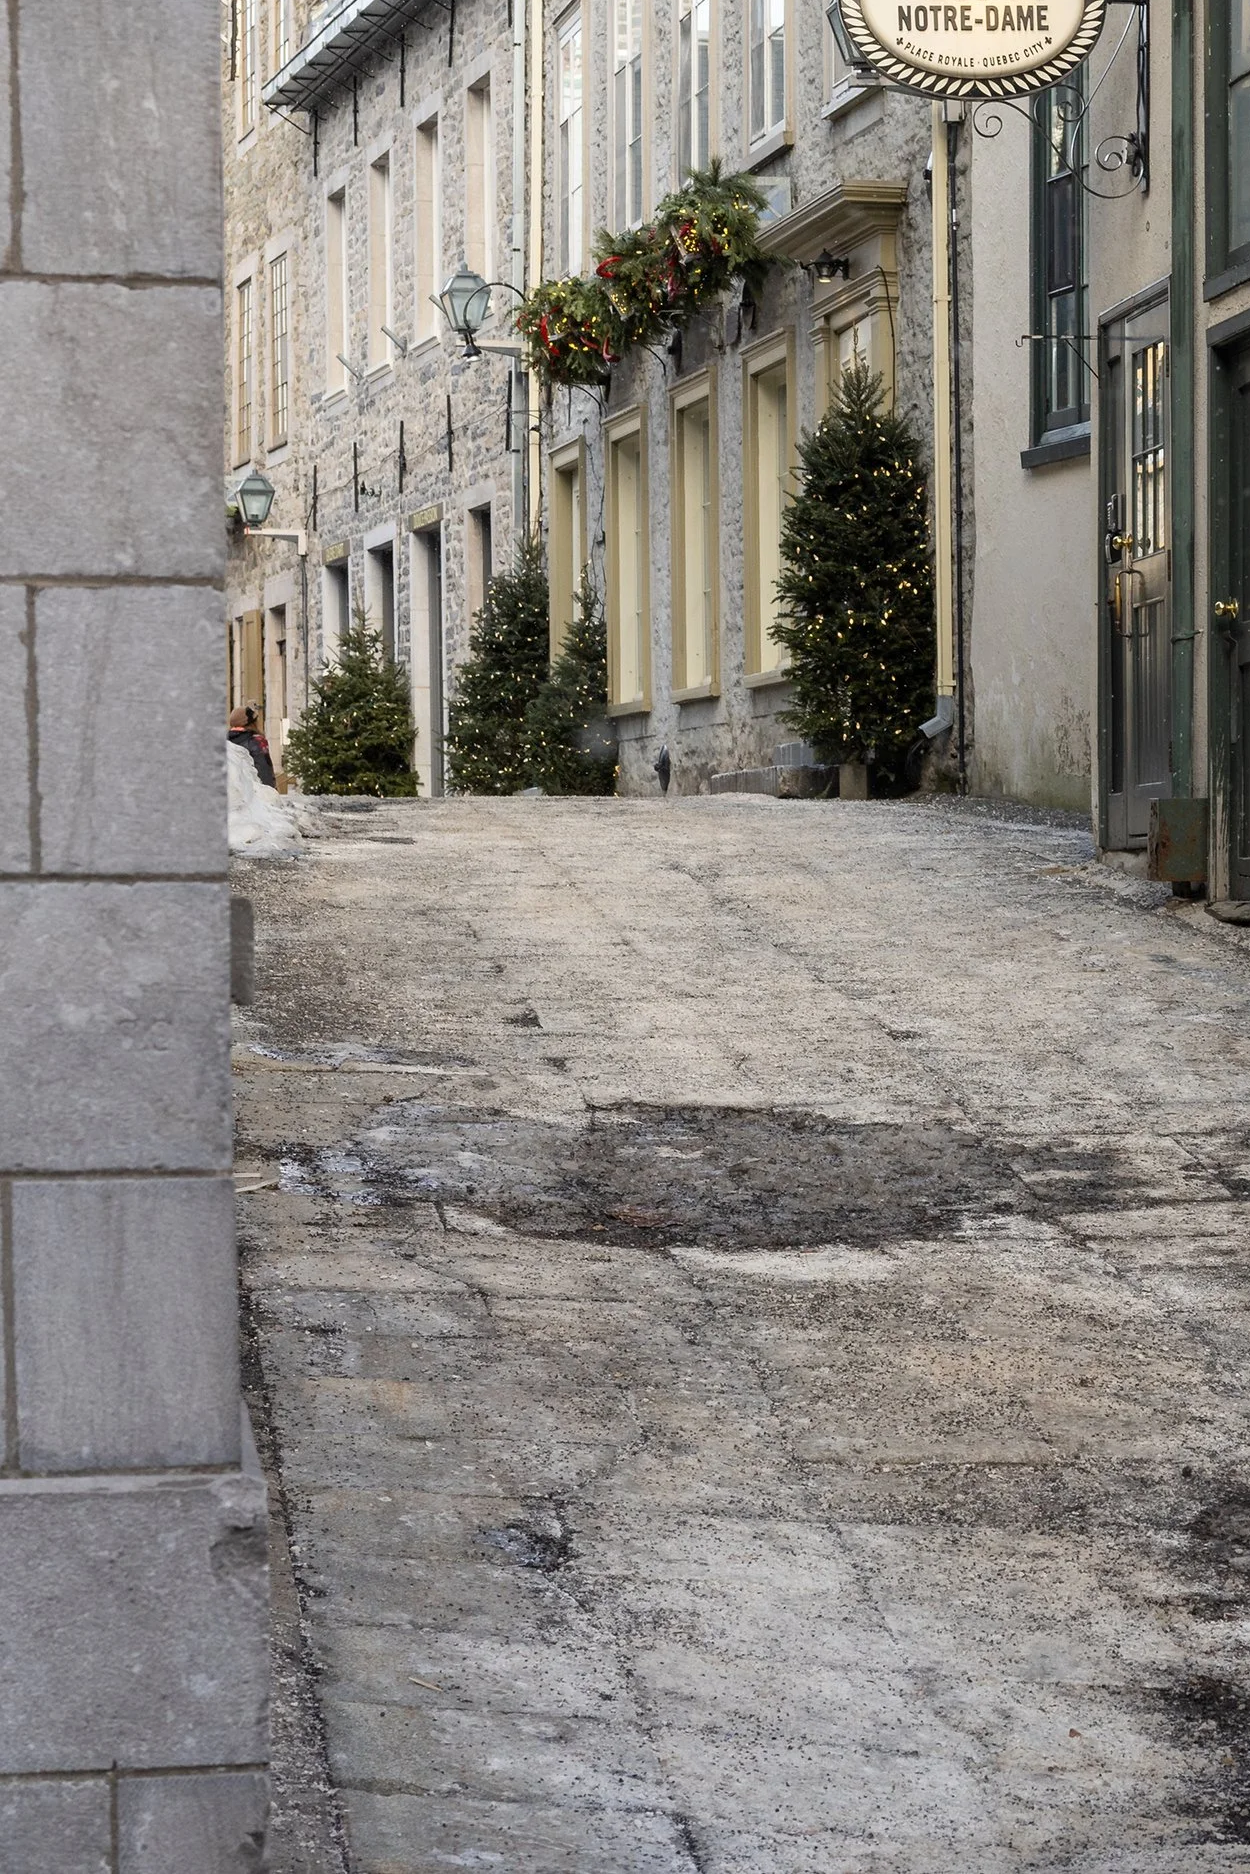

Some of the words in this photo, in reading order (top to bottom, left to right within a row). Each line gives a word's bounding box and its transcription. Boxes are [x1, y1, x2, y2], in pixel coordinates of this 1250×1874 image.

[897, 5, 1050, 32] NOTRE-DAME
[903, 41, 935, 62] PLACE
[937, 54, 975, 68] ROYALE
[982, 52, 1021, 68] QUEBEC
[1023, 41, 1045, 58] CITY
